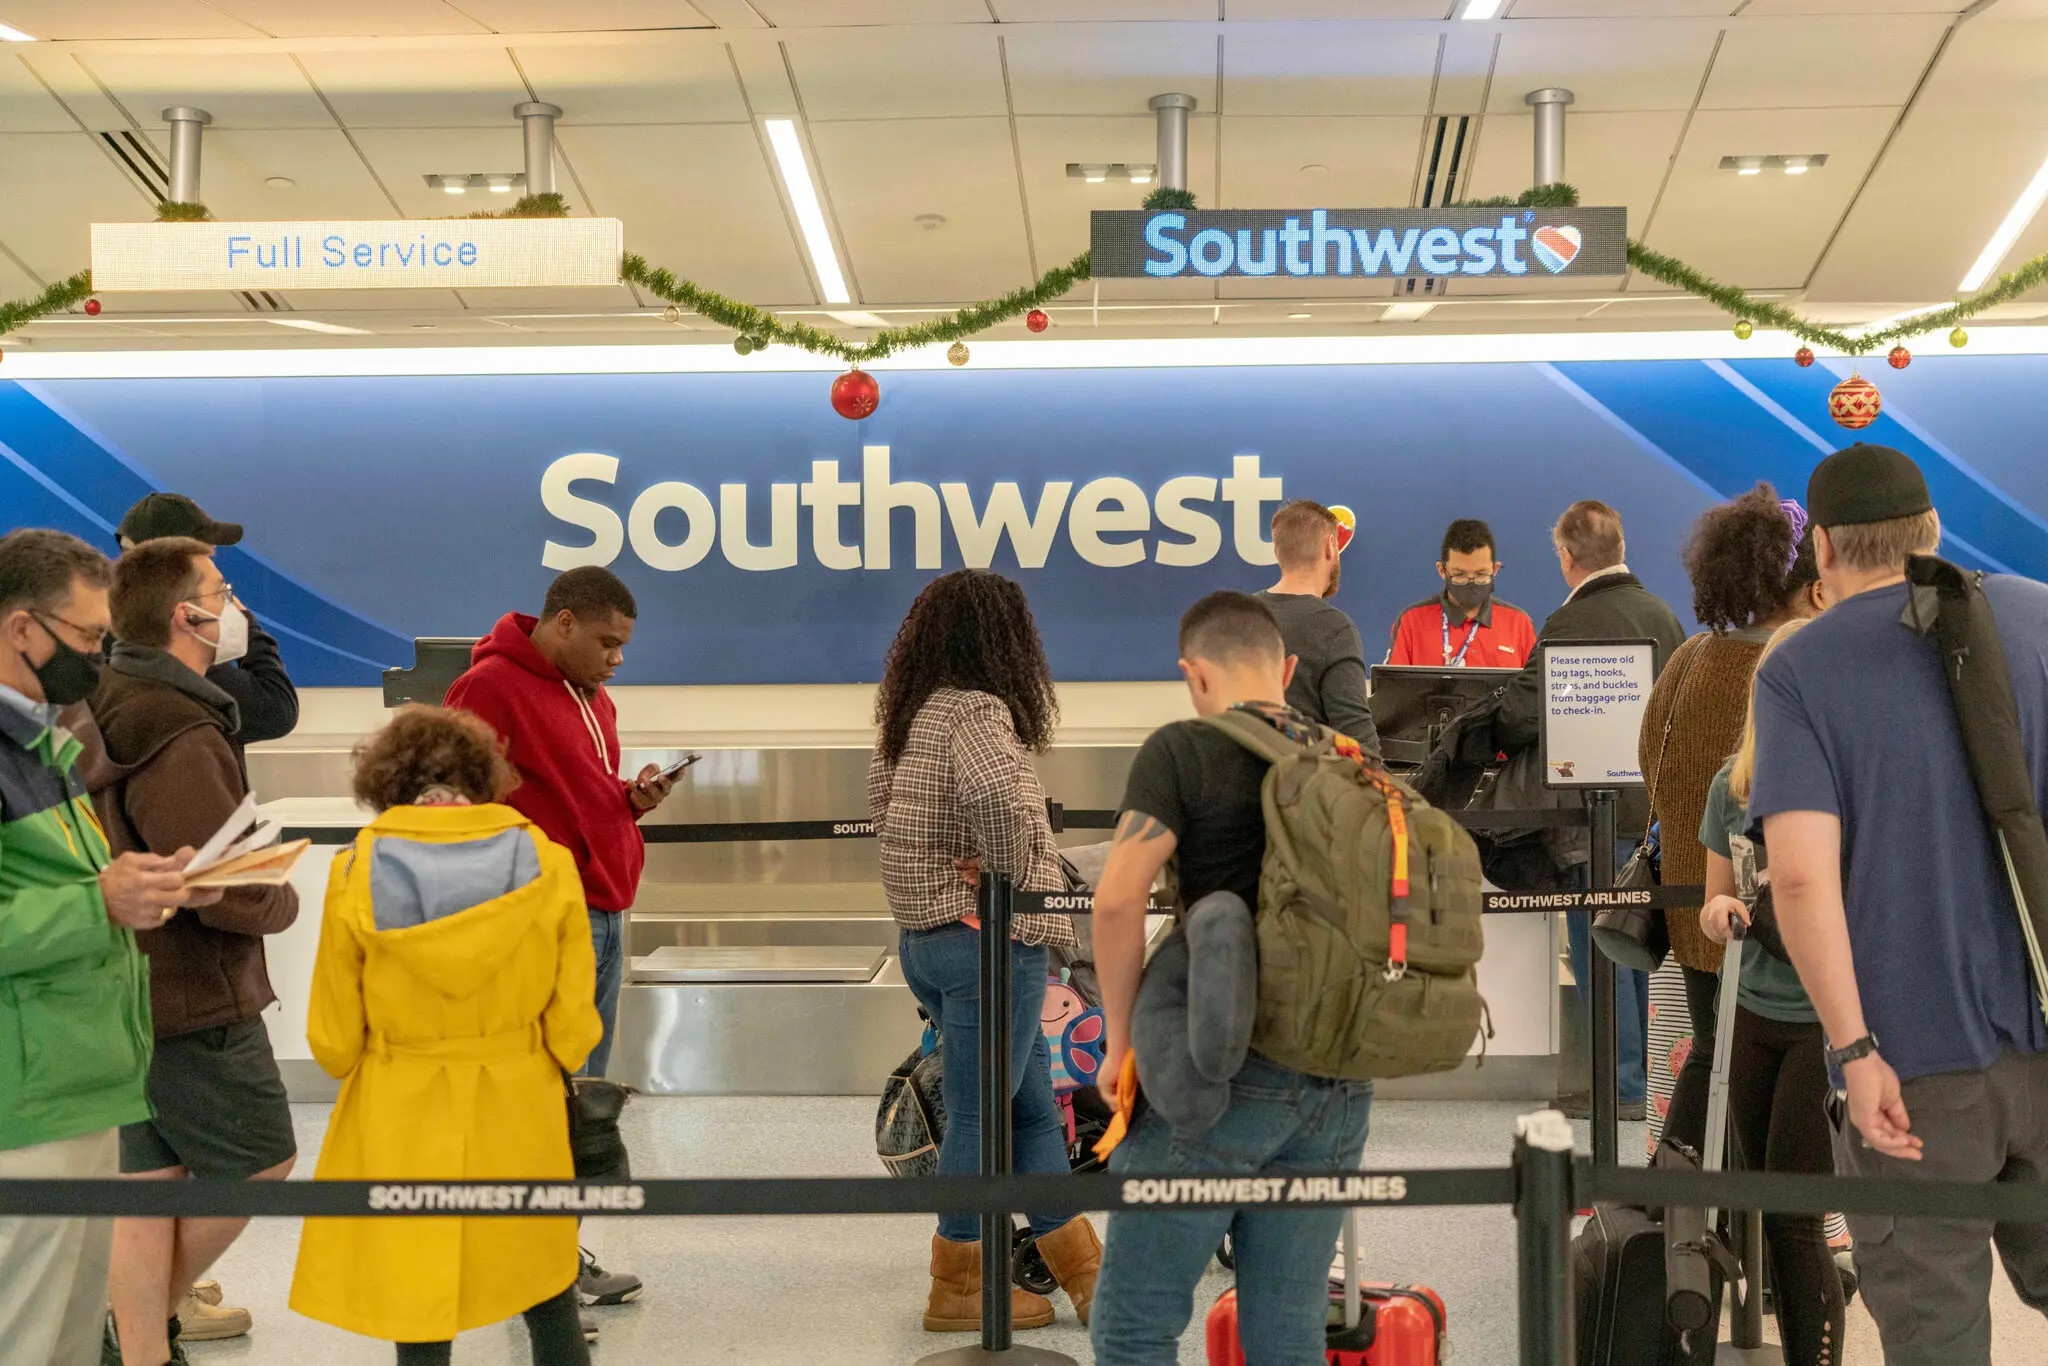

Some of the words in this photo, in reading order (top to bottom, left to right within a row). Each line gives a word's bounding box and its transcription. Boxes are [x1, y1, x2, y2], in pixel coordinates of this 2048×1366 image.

[1144, 209, 1530, 277] Southwest
[228, 236, 301, 268] Full
[322, 234, 477, 268] Service
[540, 445, 1283, 572] Southwest
[1550, 656, 1580, 664] Please
[1582, 656, 1617, 664] remove
[1619, 655, 1634, 664] old
[1550, 669, 1568, 679] bag
[1570, 669, 1592, 678] tags,
[1594, 668, 1626, 677] hooks,
[1583, 681, 1600, 689] and
[1602, 680, 1638, 688] buckles
[1552, 694, 1573, 702] from
[1576, 694, 1616, 704] baggage
[1618, 692, 1641, 703] prior
[1552, 706, 1561, 714] to
[1563, 706, 1606, 714] check-in.
[833, 823, 874, 834] SOUTH
[1044, 896, 1095, 909] SOUTH
[1488, 894, 1582, 908] SOUTHWEST
[1584, 891, 1651, 905] AIRLINES
[1122, 1178, 1286, 1203] SOUTHWEST
[1286, 1175, 1407, 1201] AIRLINES
[368, 1185, 528, 1210] SOUTHWEST
[528, 1185, 645, 1210] AIRLINES
